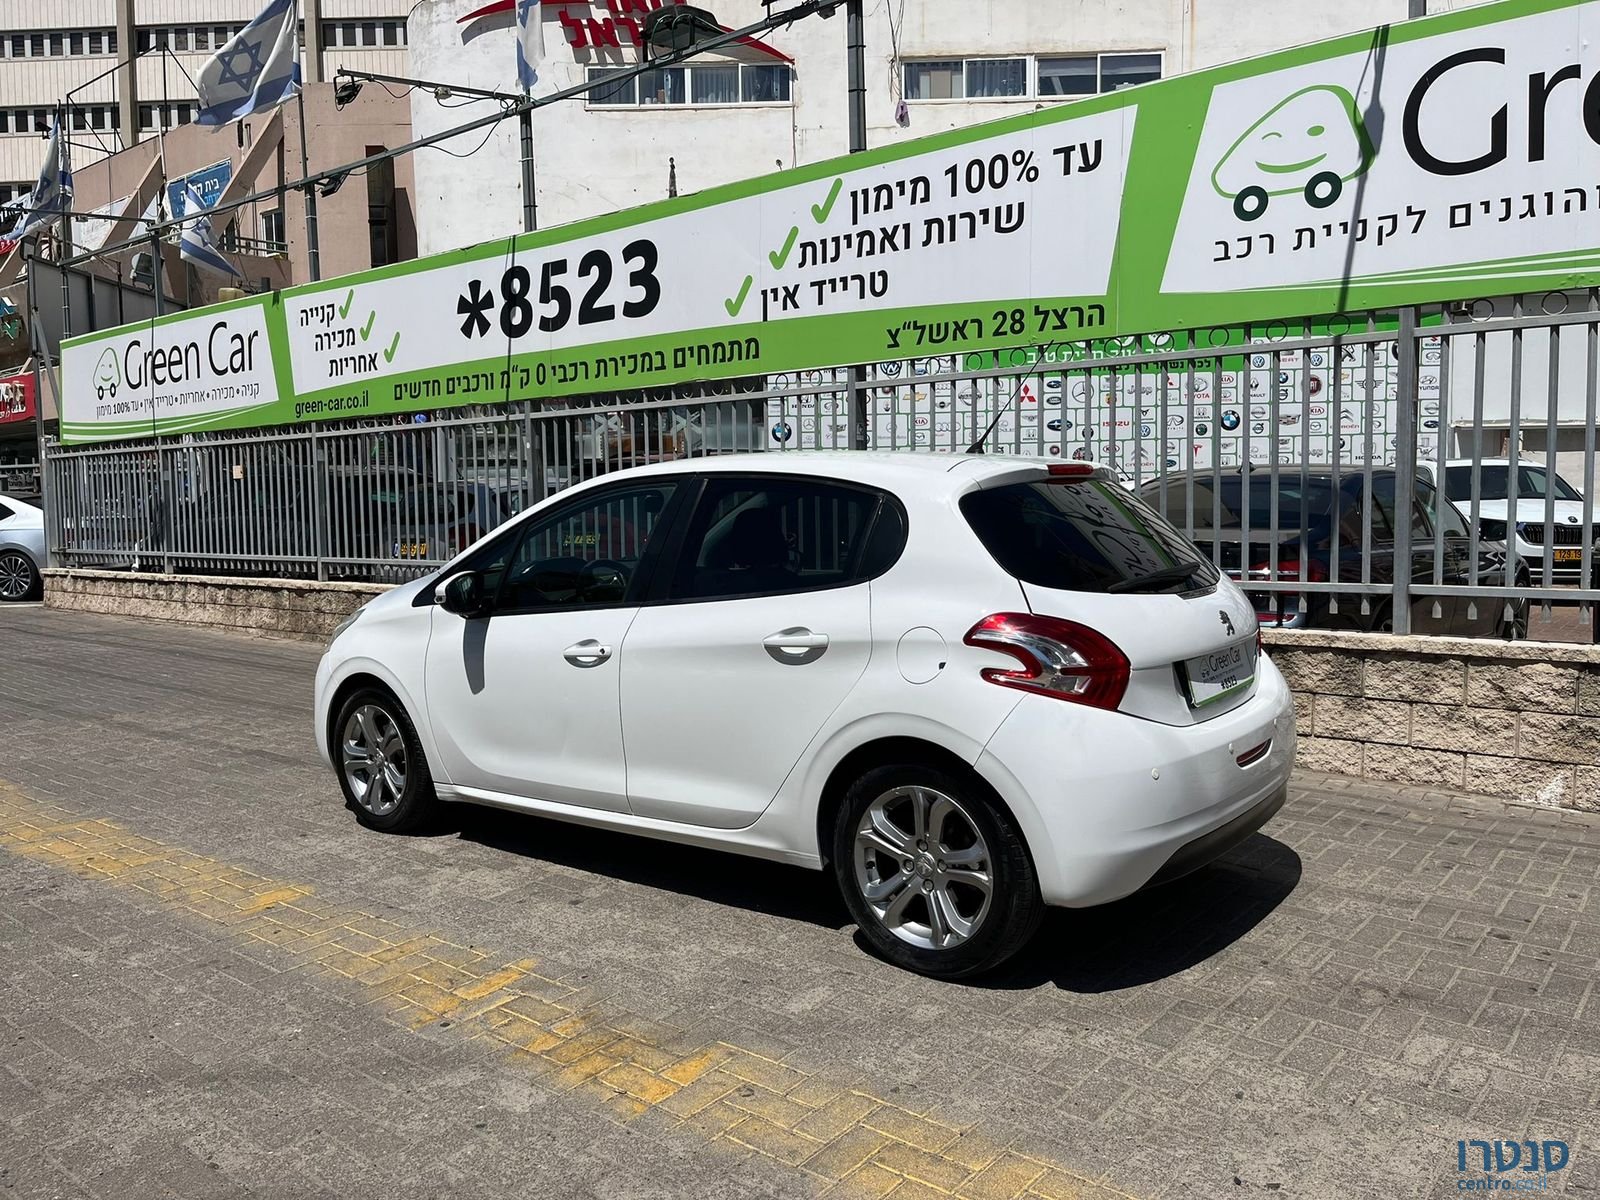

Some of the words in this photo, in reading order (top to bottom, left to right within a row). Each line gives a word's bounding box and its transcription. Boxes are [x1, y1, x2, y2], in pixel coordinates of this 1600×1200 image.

[1403, 47, 1600, 175] Gr
[1052, 139, 1102, 176] עד
[944, 150, 1039, 198] 100%
[850, 176, 930, 225] מימון
[922, 202, 1025, 247] שירות
[1293, 205, 1427, 251] לקניית
[798, 223, 910, 269] ואמינות
[1213, 233, 1274, 262] רכב
[810, 269, 888, 306] טרייד
[300, 303, 335, 327] קנייה
[761, 284, 800, 321] אין
[992, 309, 1025, 337] 28
[1034, 303, 1105, 332] הרצל
[315, 328, 356, 351] מכירה
[674, 337, 760, 368] מתמחים
[125, 340, 201, 390] Green
[208, 321, 259, 376] Car
[328, 352, 378, 377] אחריות
[595, 351, 666, 378] במכירת
[446, 372, 494, 394] ורכבים
[536, 362, 546, 386] 0
[550, 361, 589, 384] רכבי
[155, 393, 174, 408] טרייד
[179, 391, 206, 405] אחריות
[211, 386, 235, 401] מכירה
[241, 382, 260, 399] קניה
[394, 379, 441, 400] חדשים
[96, 403, 112, 419] מימון
[113, 401, 131, 414] 100%
[131, 400, 139, 411] עד
[295, 390, 369, 418] green-car.co.il
[1209, 652, 1231, 672] Green
[1230, 647, 1240, 664] Car
